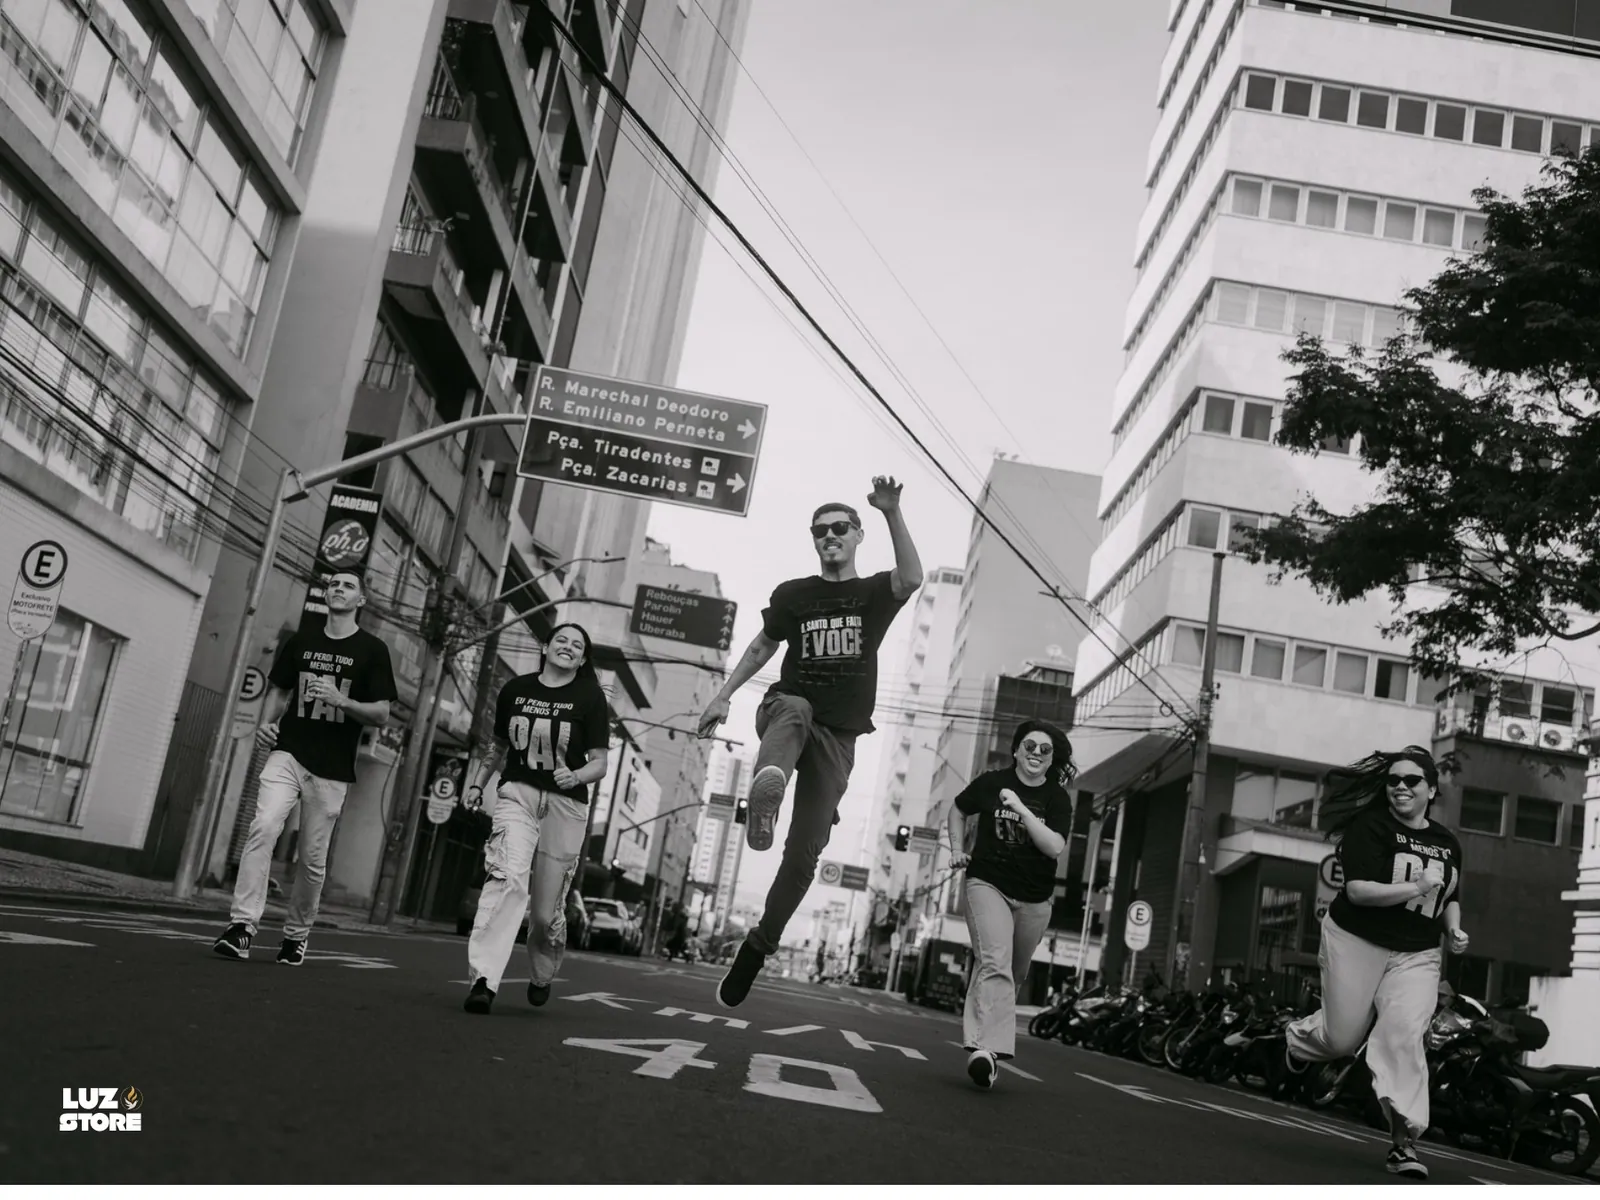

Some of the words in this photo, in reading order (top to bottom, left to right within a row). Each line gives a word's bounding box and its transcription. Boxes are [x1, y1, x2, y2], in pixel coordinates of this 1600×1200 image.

[541, 376, 555, 390] R.
[565, 381, 649, 407] Marechal
[656, 397, 729, 422] Deodoro
[539, 396, 554, 411] R.
[564, 401, 646, 427] Emiliano
[654, 418, 726, 442] Perneta
[547, 431, 584, 450] Pça.
[594, 439, 692, 469] Tiradentes
[561, 458, 597, 477] Pça.
[606, 466, 687, 493] Zacarias
[331, 494, 378, 513] ACADEMIA
[34, 550, 55, 578] E
[646, 589, 699, 607] Rebouças
[13, 600, 53, 612] MOTOFRETE
[643, 600, 681, 615] Parolin
[641, 611, 674, 625] Hauer
[806, 619, 828, 631] SANTO
[830, 617, 843, 629] QUE
[639, 623, 686, 639] Uberaba
[303, 651, 312, 660] EU
[313, 652, 333, 662] PERDI
[335, 654, 354, 666] TUDO
[309, 661, 334, 672] MENOS
[336, 664, 342, 673] O
[241, 673, 256, 694] E
[515, 696, 524, 705] EU
[526, 698, 550, 708] PERDI
[552, 702, 573, 710] TUDO
[522, 705, 550, 716] MENOS
[439, 781, 450, 794] E
[1396, 833, 1407, 844] EU
[1410, 843, 1439, 858] MENOS
[1136, 908, 1145, 921] E
[562, 1036, 884, 1113] 40
